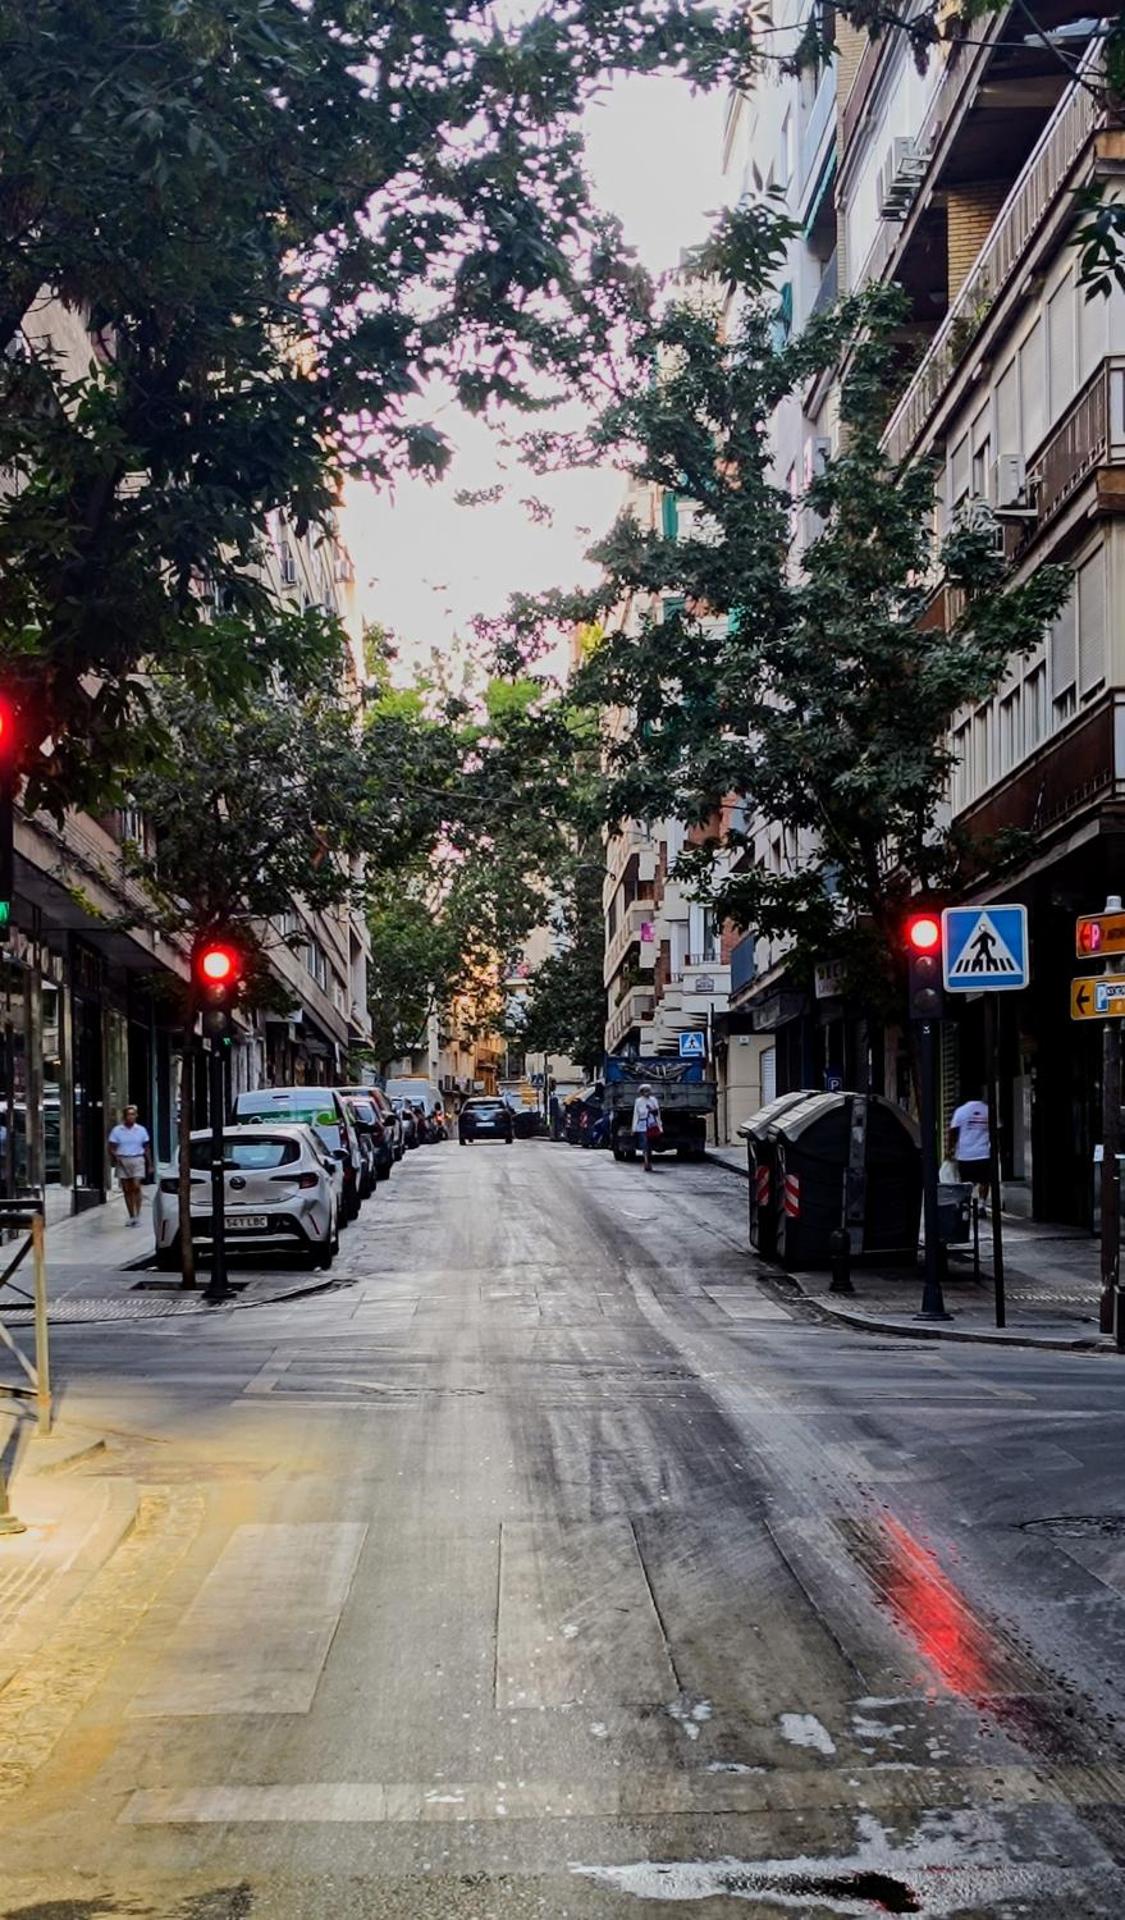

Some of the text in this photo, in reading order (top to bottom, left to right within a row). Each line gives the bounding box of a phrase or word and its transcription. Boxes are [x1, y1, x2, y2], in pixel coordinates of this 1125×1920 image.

[1091, 923, 1100, 949] P
[1096, 985, 1107, 1009] P
[831, 1079, 840, 1090] P
